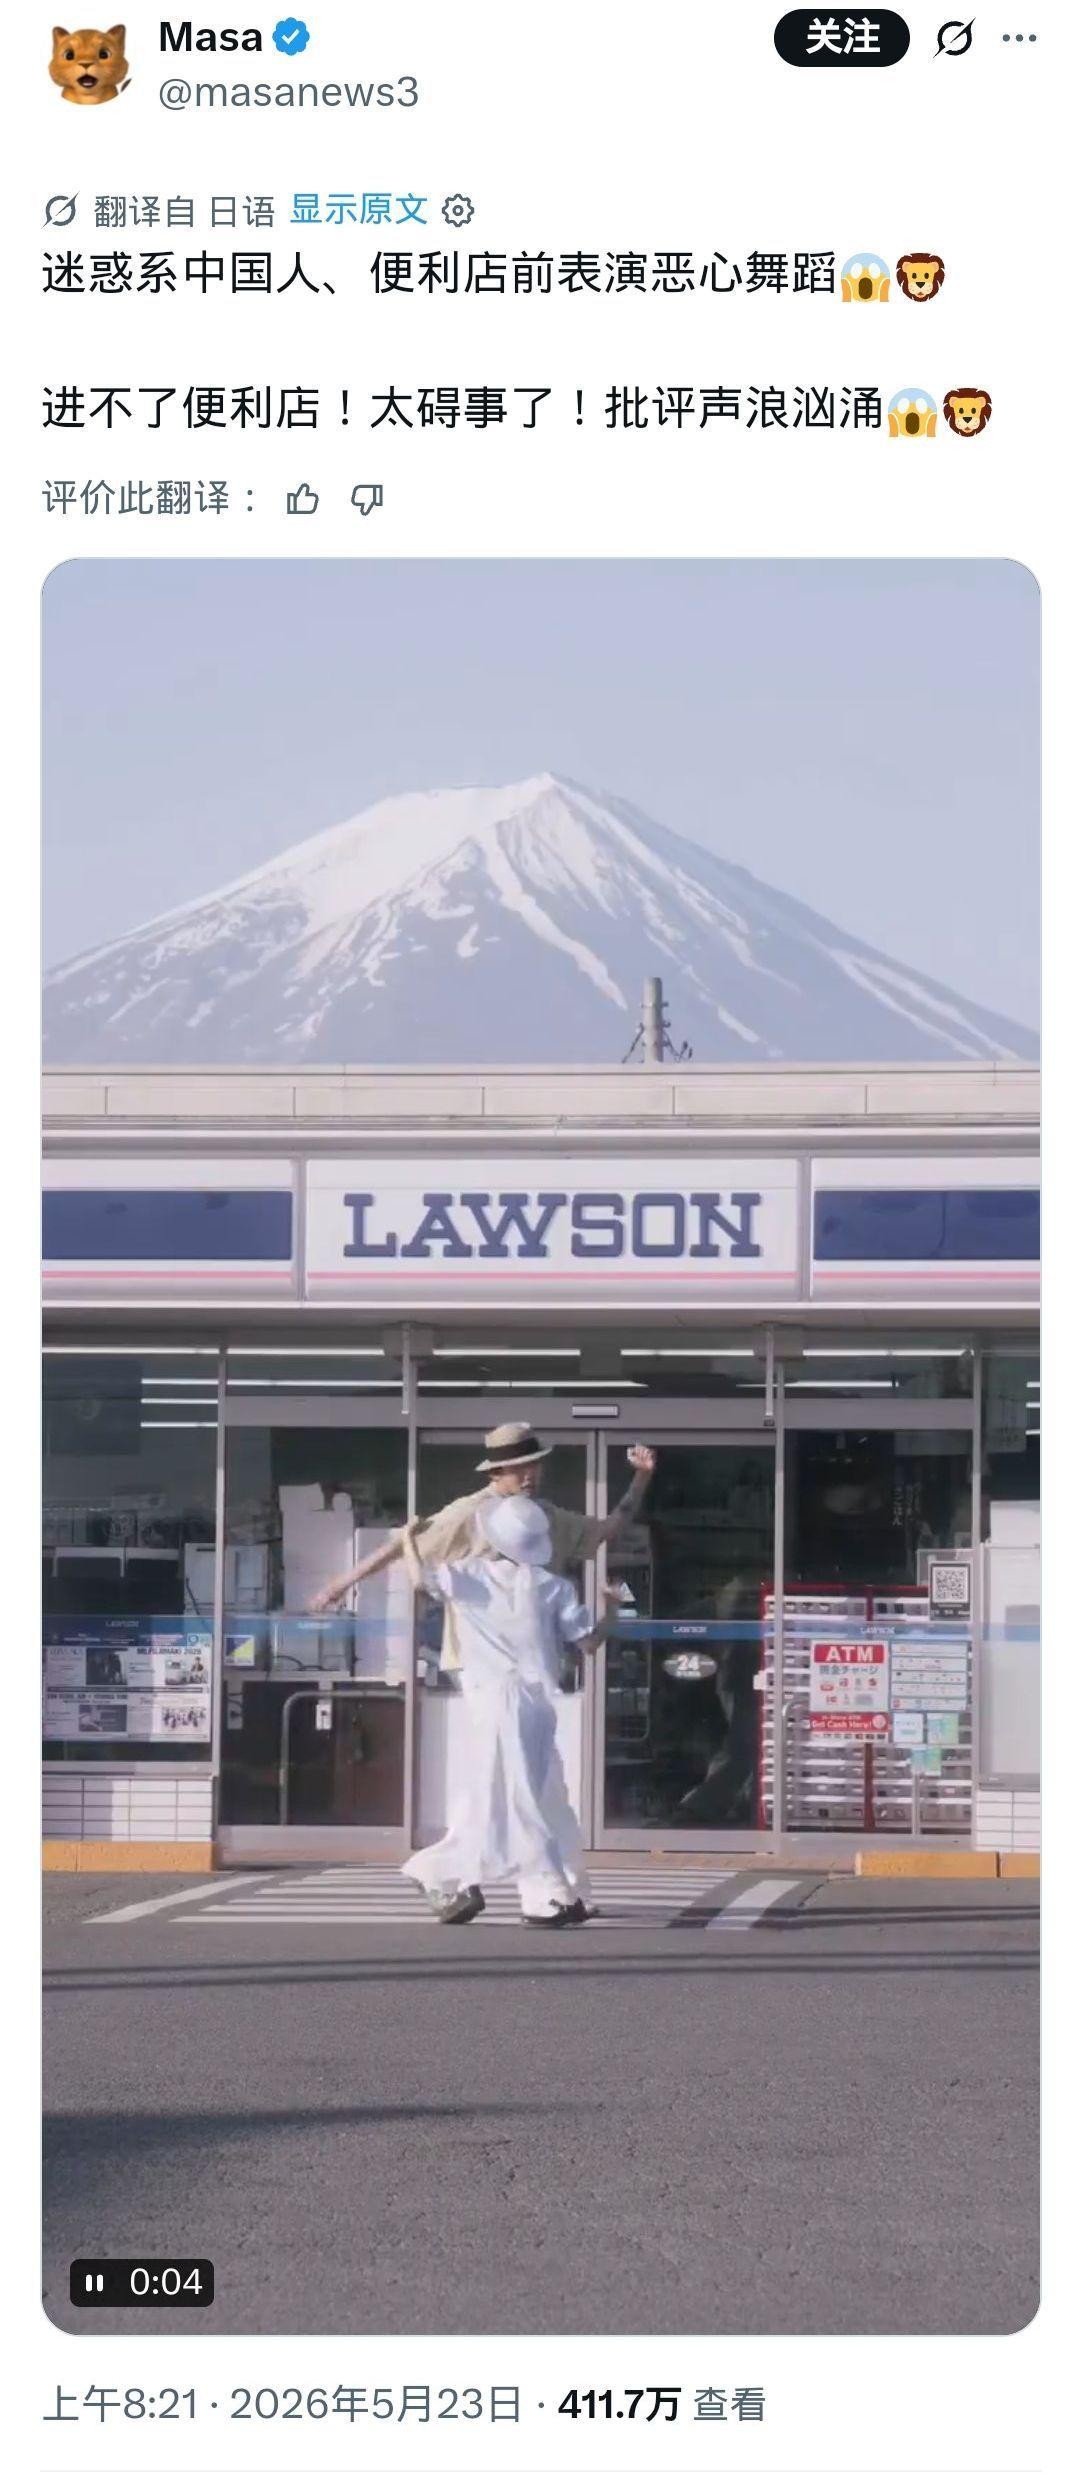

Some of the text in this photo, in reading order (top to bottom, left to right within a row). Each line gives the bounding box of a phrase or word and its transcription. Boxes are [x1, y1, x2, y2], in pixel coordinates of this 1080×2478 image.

[342, 1192, 763, 1258] LAWSON
[824, 1646, 874, 1662] ATM
[678, 1655, 699, 1670] 24
